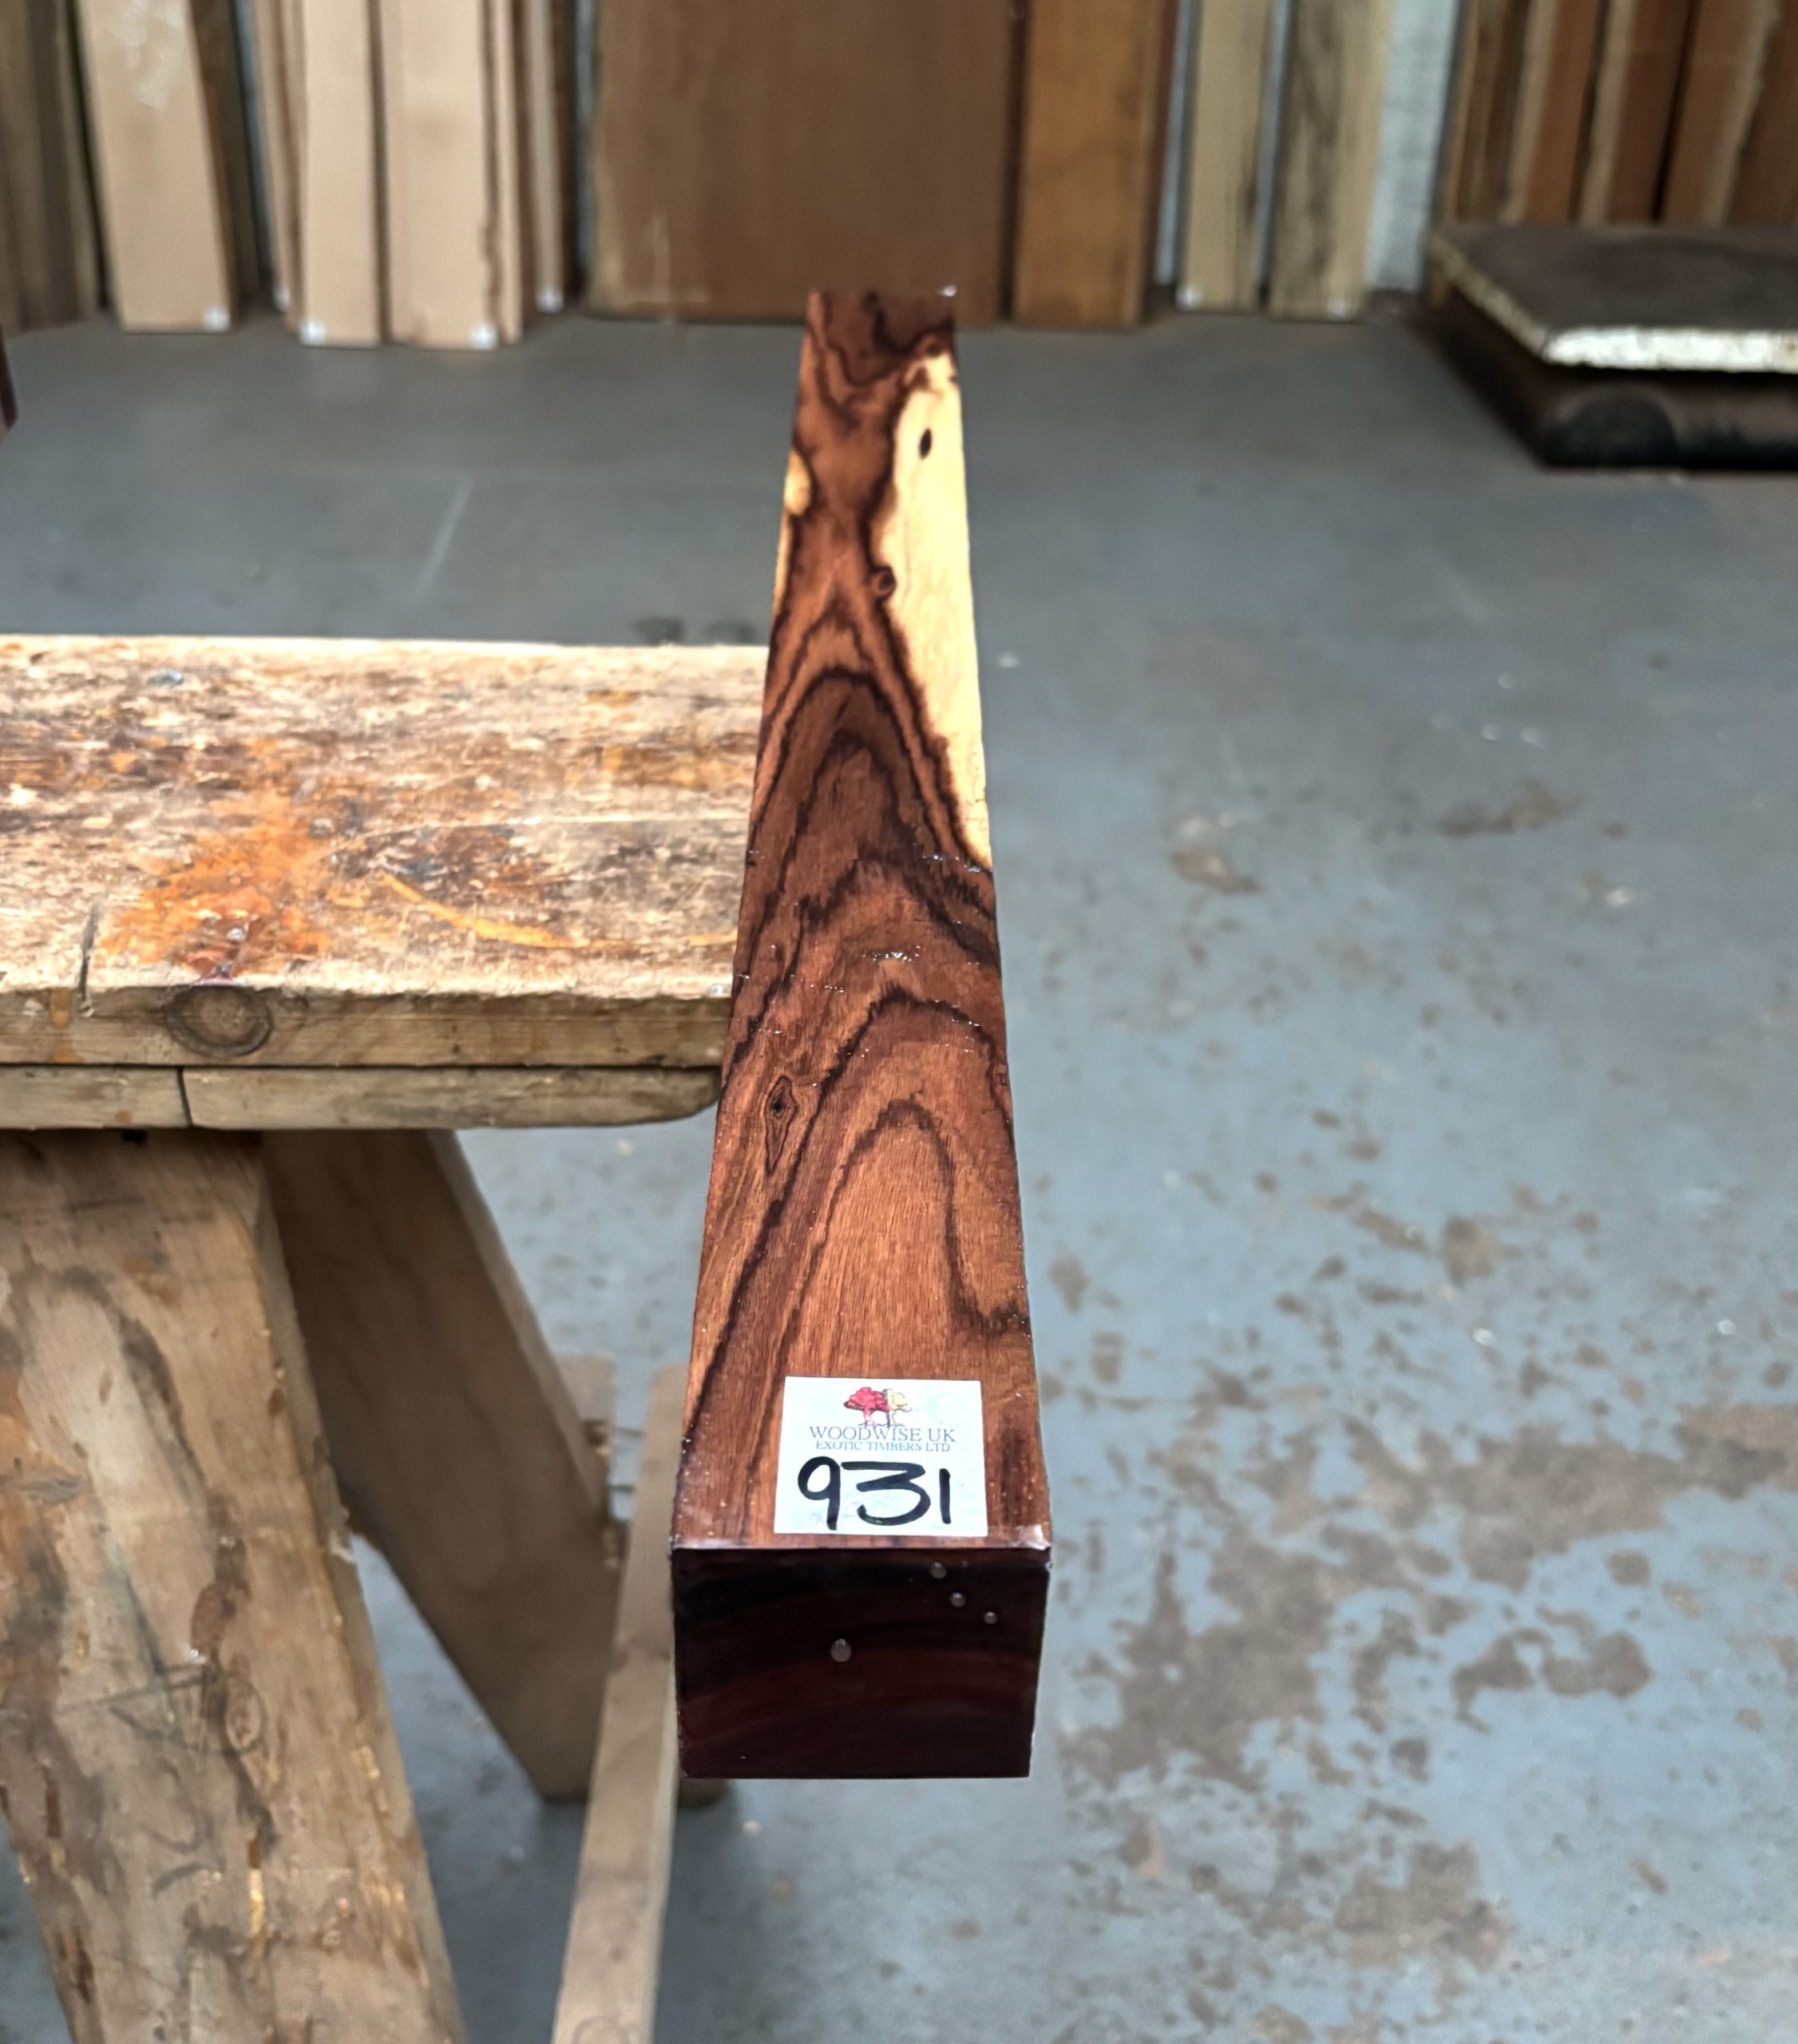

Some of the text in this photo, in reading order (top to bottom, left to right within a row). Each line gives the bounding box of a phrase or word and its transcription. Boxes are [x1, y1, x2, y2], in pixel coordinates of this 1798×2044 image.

[810, 1426, 957, 1443] WOODWISE UK
[815, 1440, 950, 1452] EXOTIC TIMBERS LTD
[798, 1456, 952, 1531] 931
